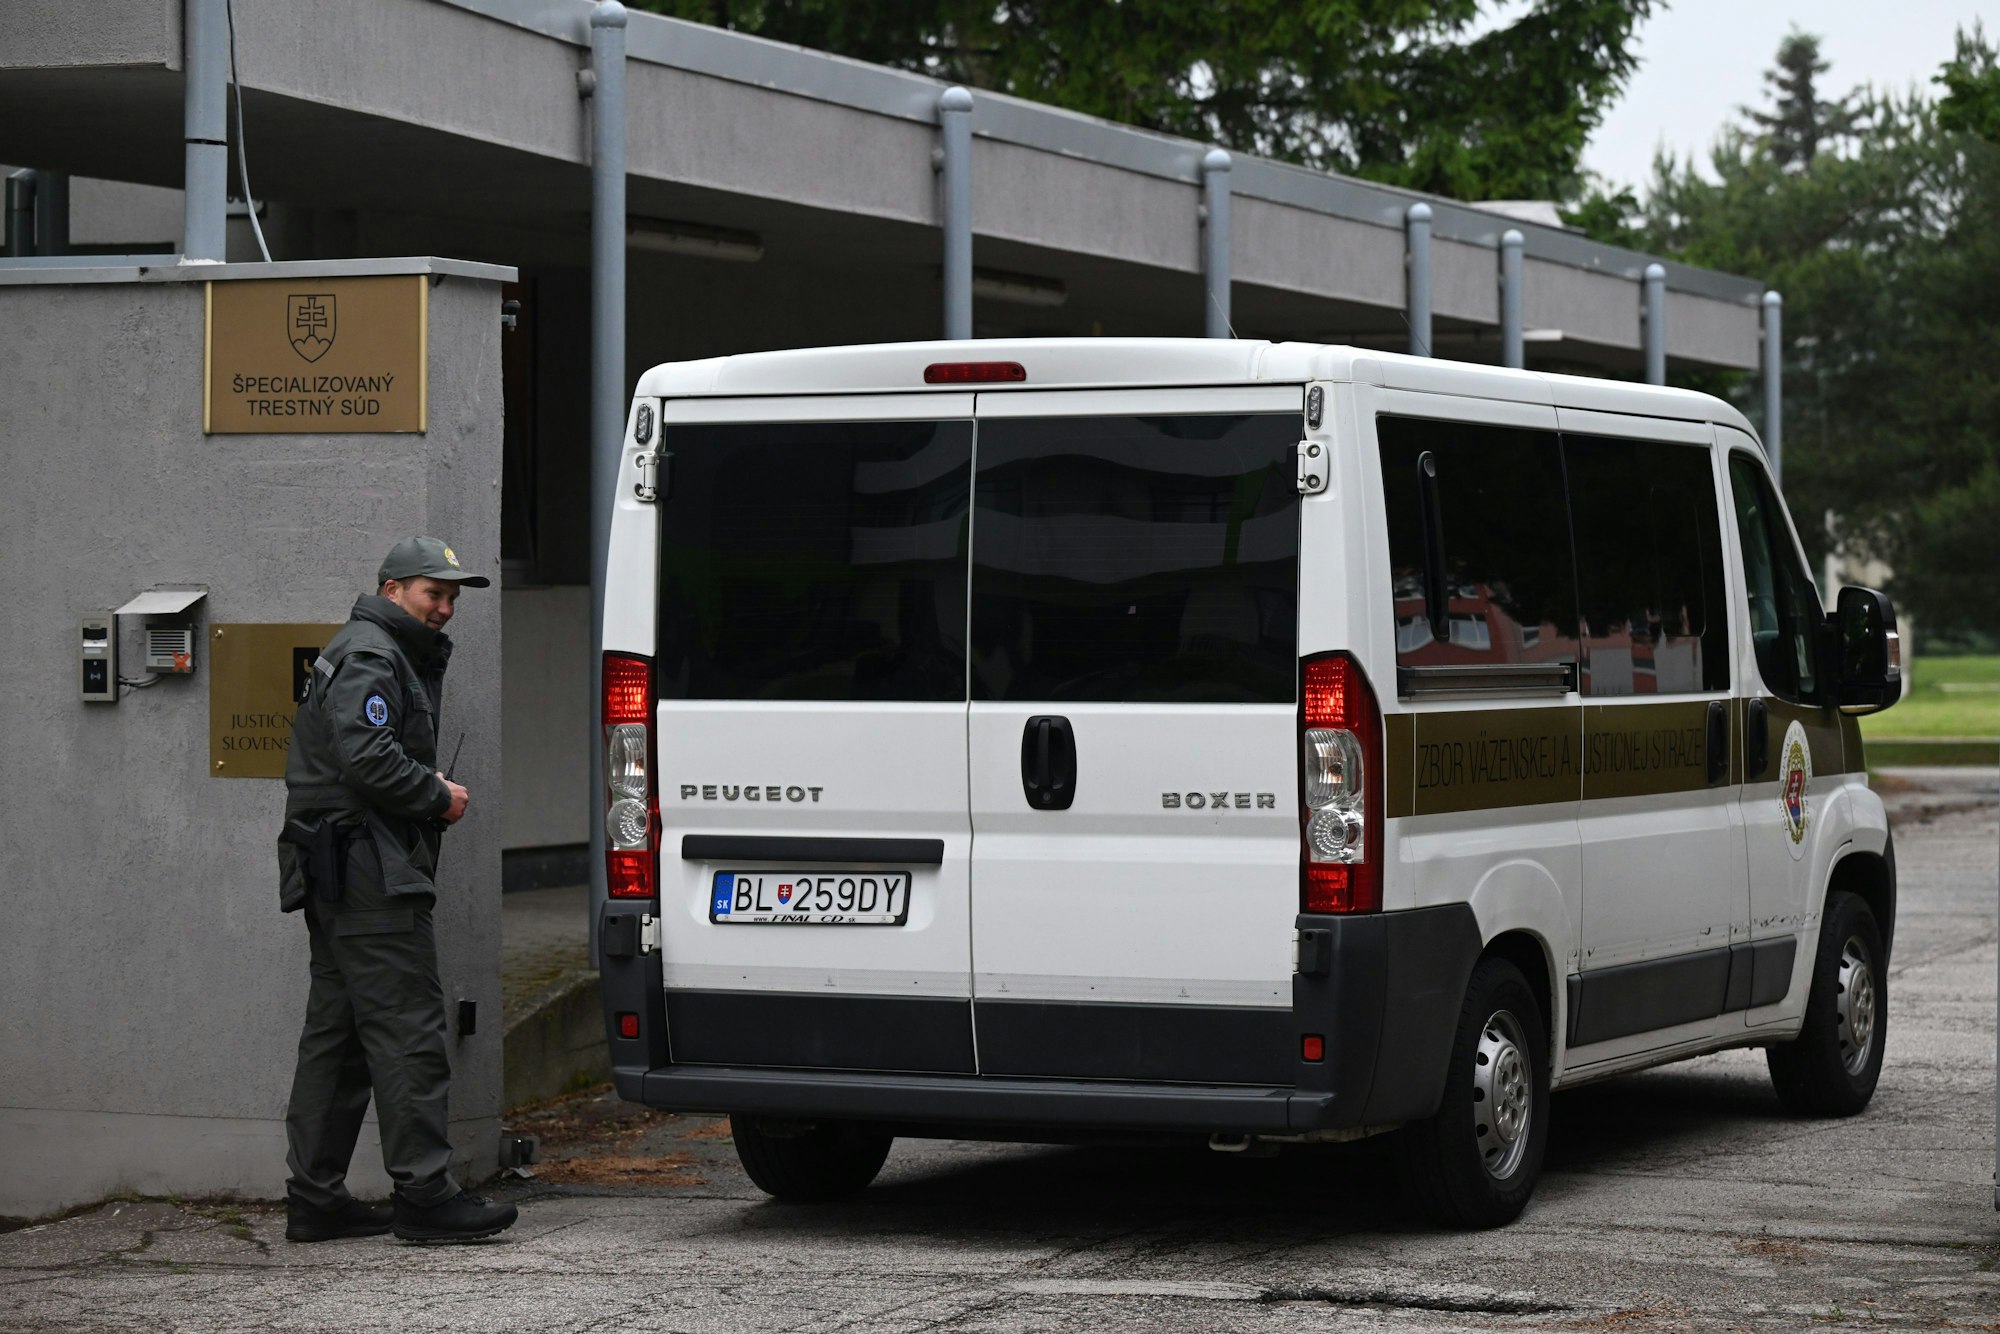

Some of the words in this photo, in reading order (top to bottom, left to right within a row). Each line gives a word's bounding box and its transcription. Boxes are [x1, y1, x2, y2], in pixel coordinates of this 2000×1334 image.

[232, 372, 394, 393] ŠPECIALIZOVANÝ
[247, 396, 334, 416] TRESTNÝ
[340, 396, 380, 416] SÚD
[1418, 742, 1464, 788] ZBOR
[1560, 735, 1571, 777] A
[680, 784, 823, 802] PEUGEOT
[1161, 791, 1275, 809] BOXER
[716, 899, 729, 910] SK
[735, 878, 773, 911] BL
[793, 878, 900, 911] 259DY
